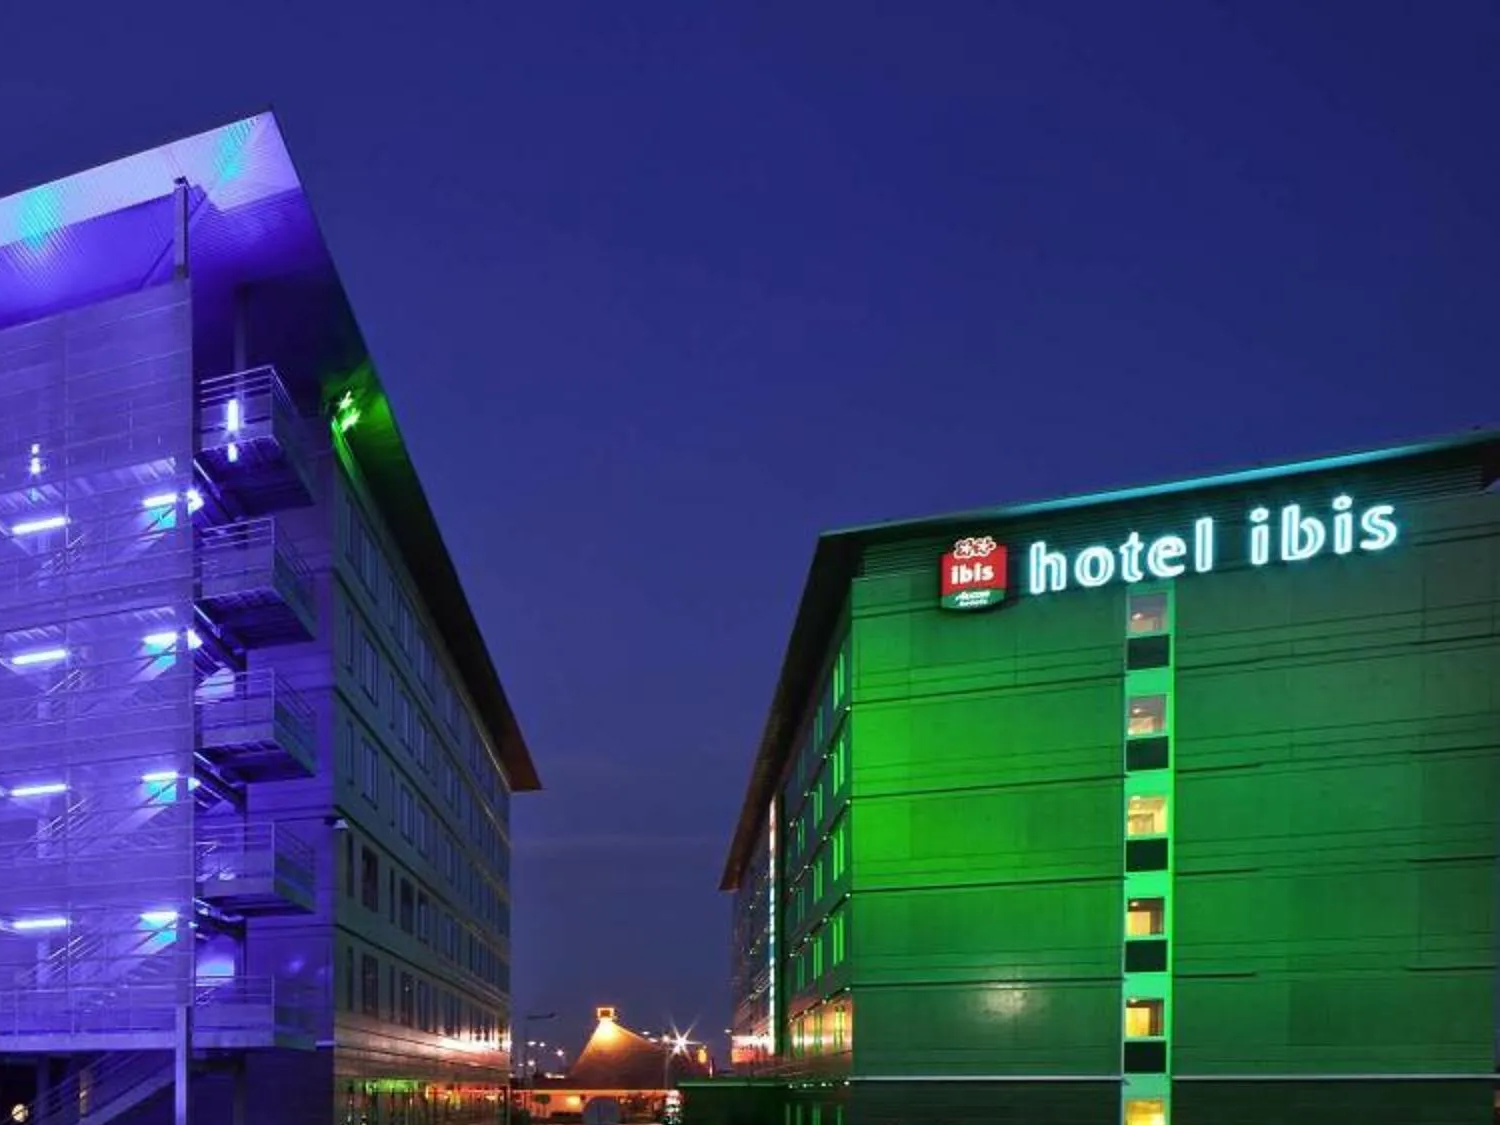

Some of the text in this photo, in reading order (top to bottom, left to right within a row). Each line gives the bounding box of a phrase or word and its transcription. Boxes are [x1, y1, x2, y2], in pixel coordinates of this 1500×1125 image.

[950, 561, 995, 585] ibis
[1028, 494, 1399, 595] hotel ibis
